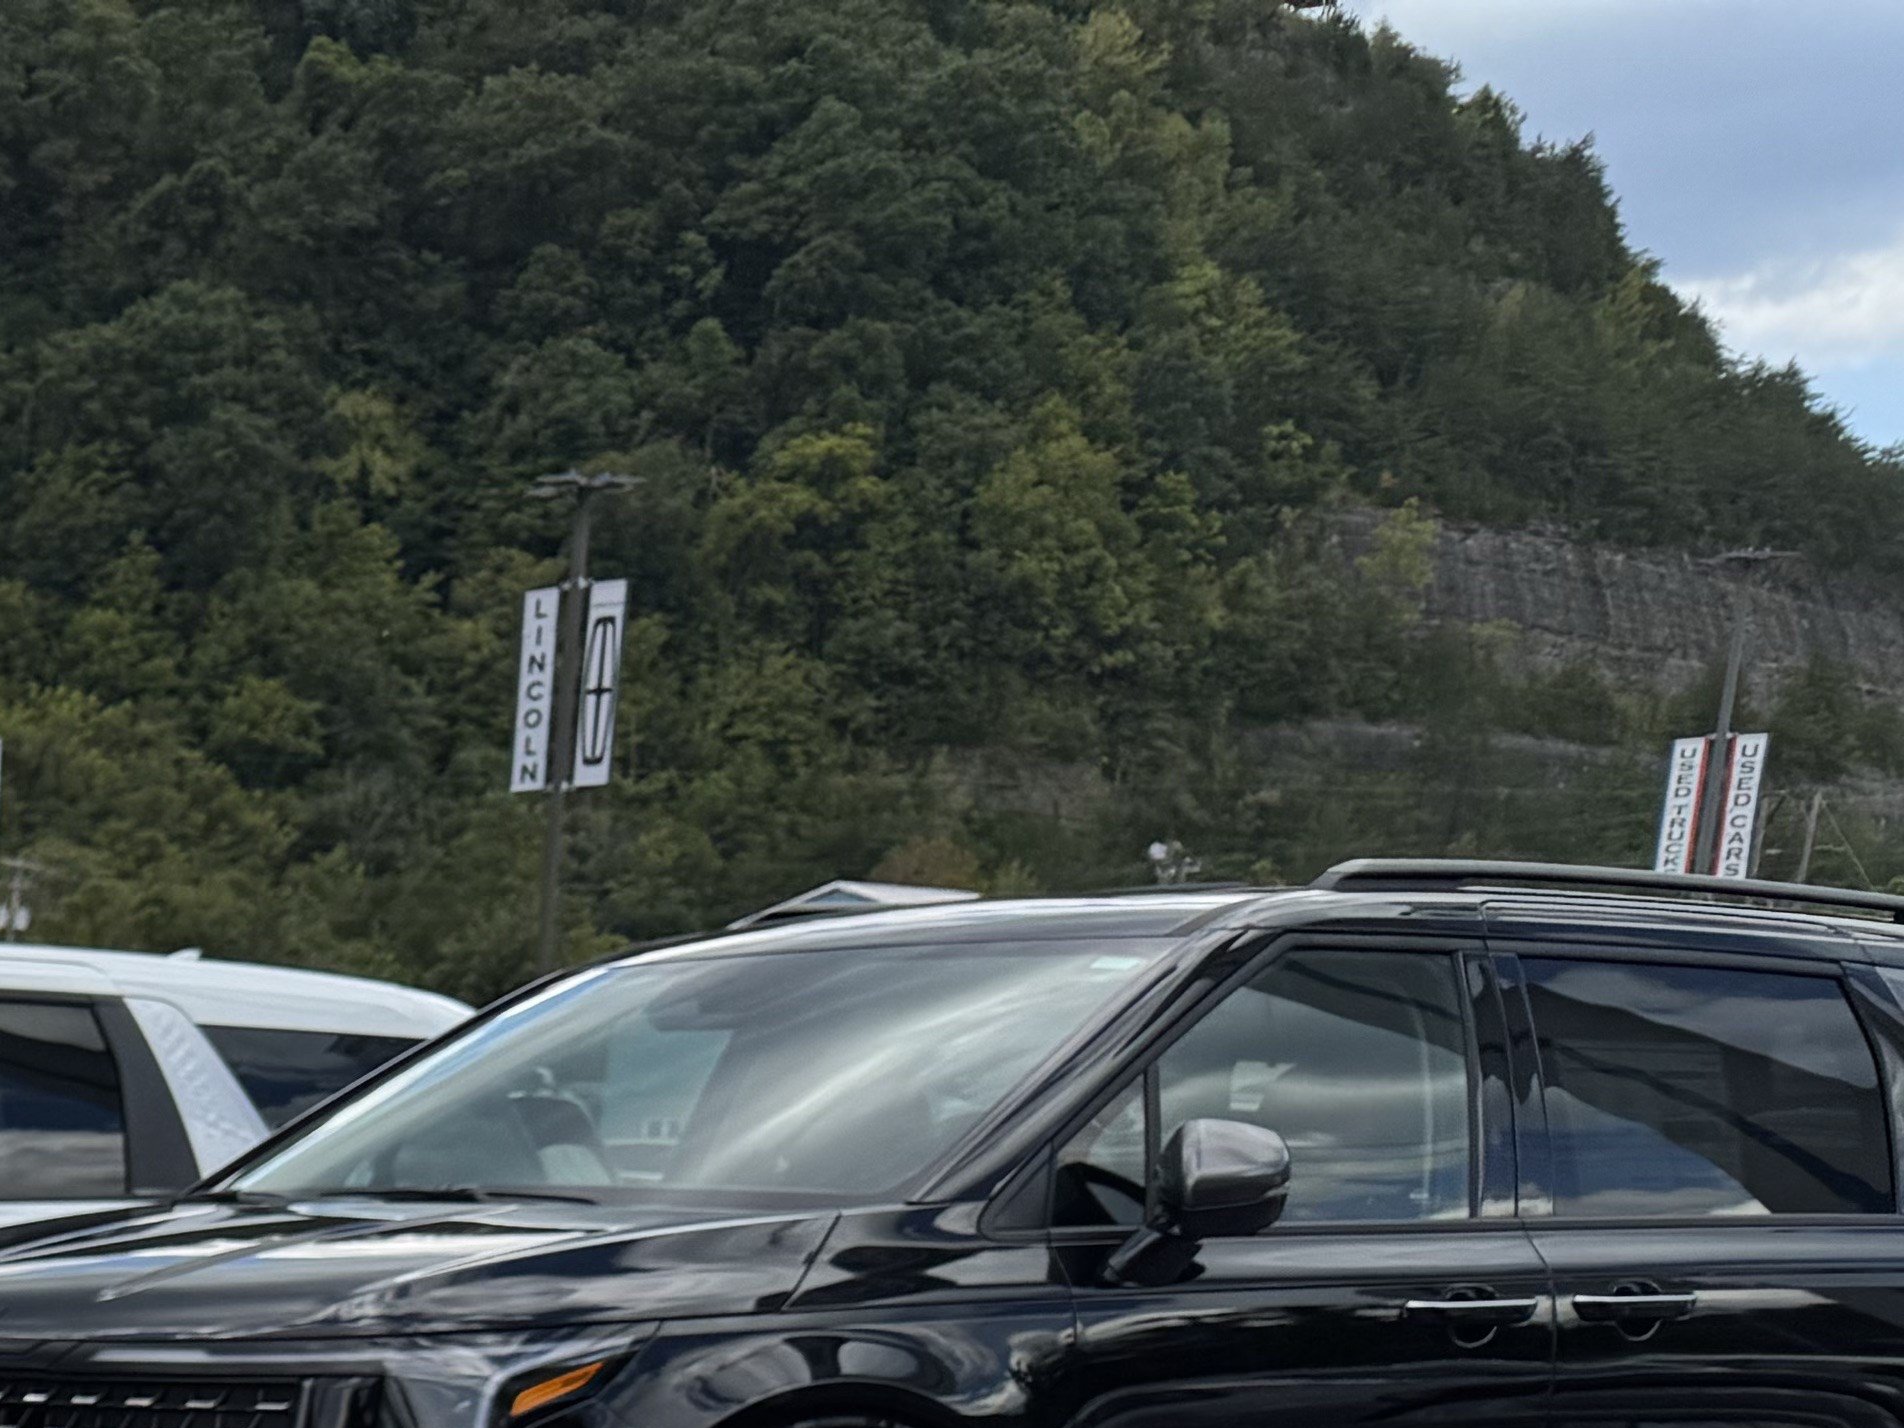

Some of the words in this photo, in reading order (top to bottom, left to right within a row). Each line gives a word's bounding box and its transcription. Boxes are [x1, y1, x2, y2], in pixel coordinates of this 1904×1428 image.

[519, 598, 548, 783] LINCOLN
[1674, 747, 1698, 799] USED
[1733, 744, 1760, 806] USED
[1724, 815, 1749, 877] CARS
